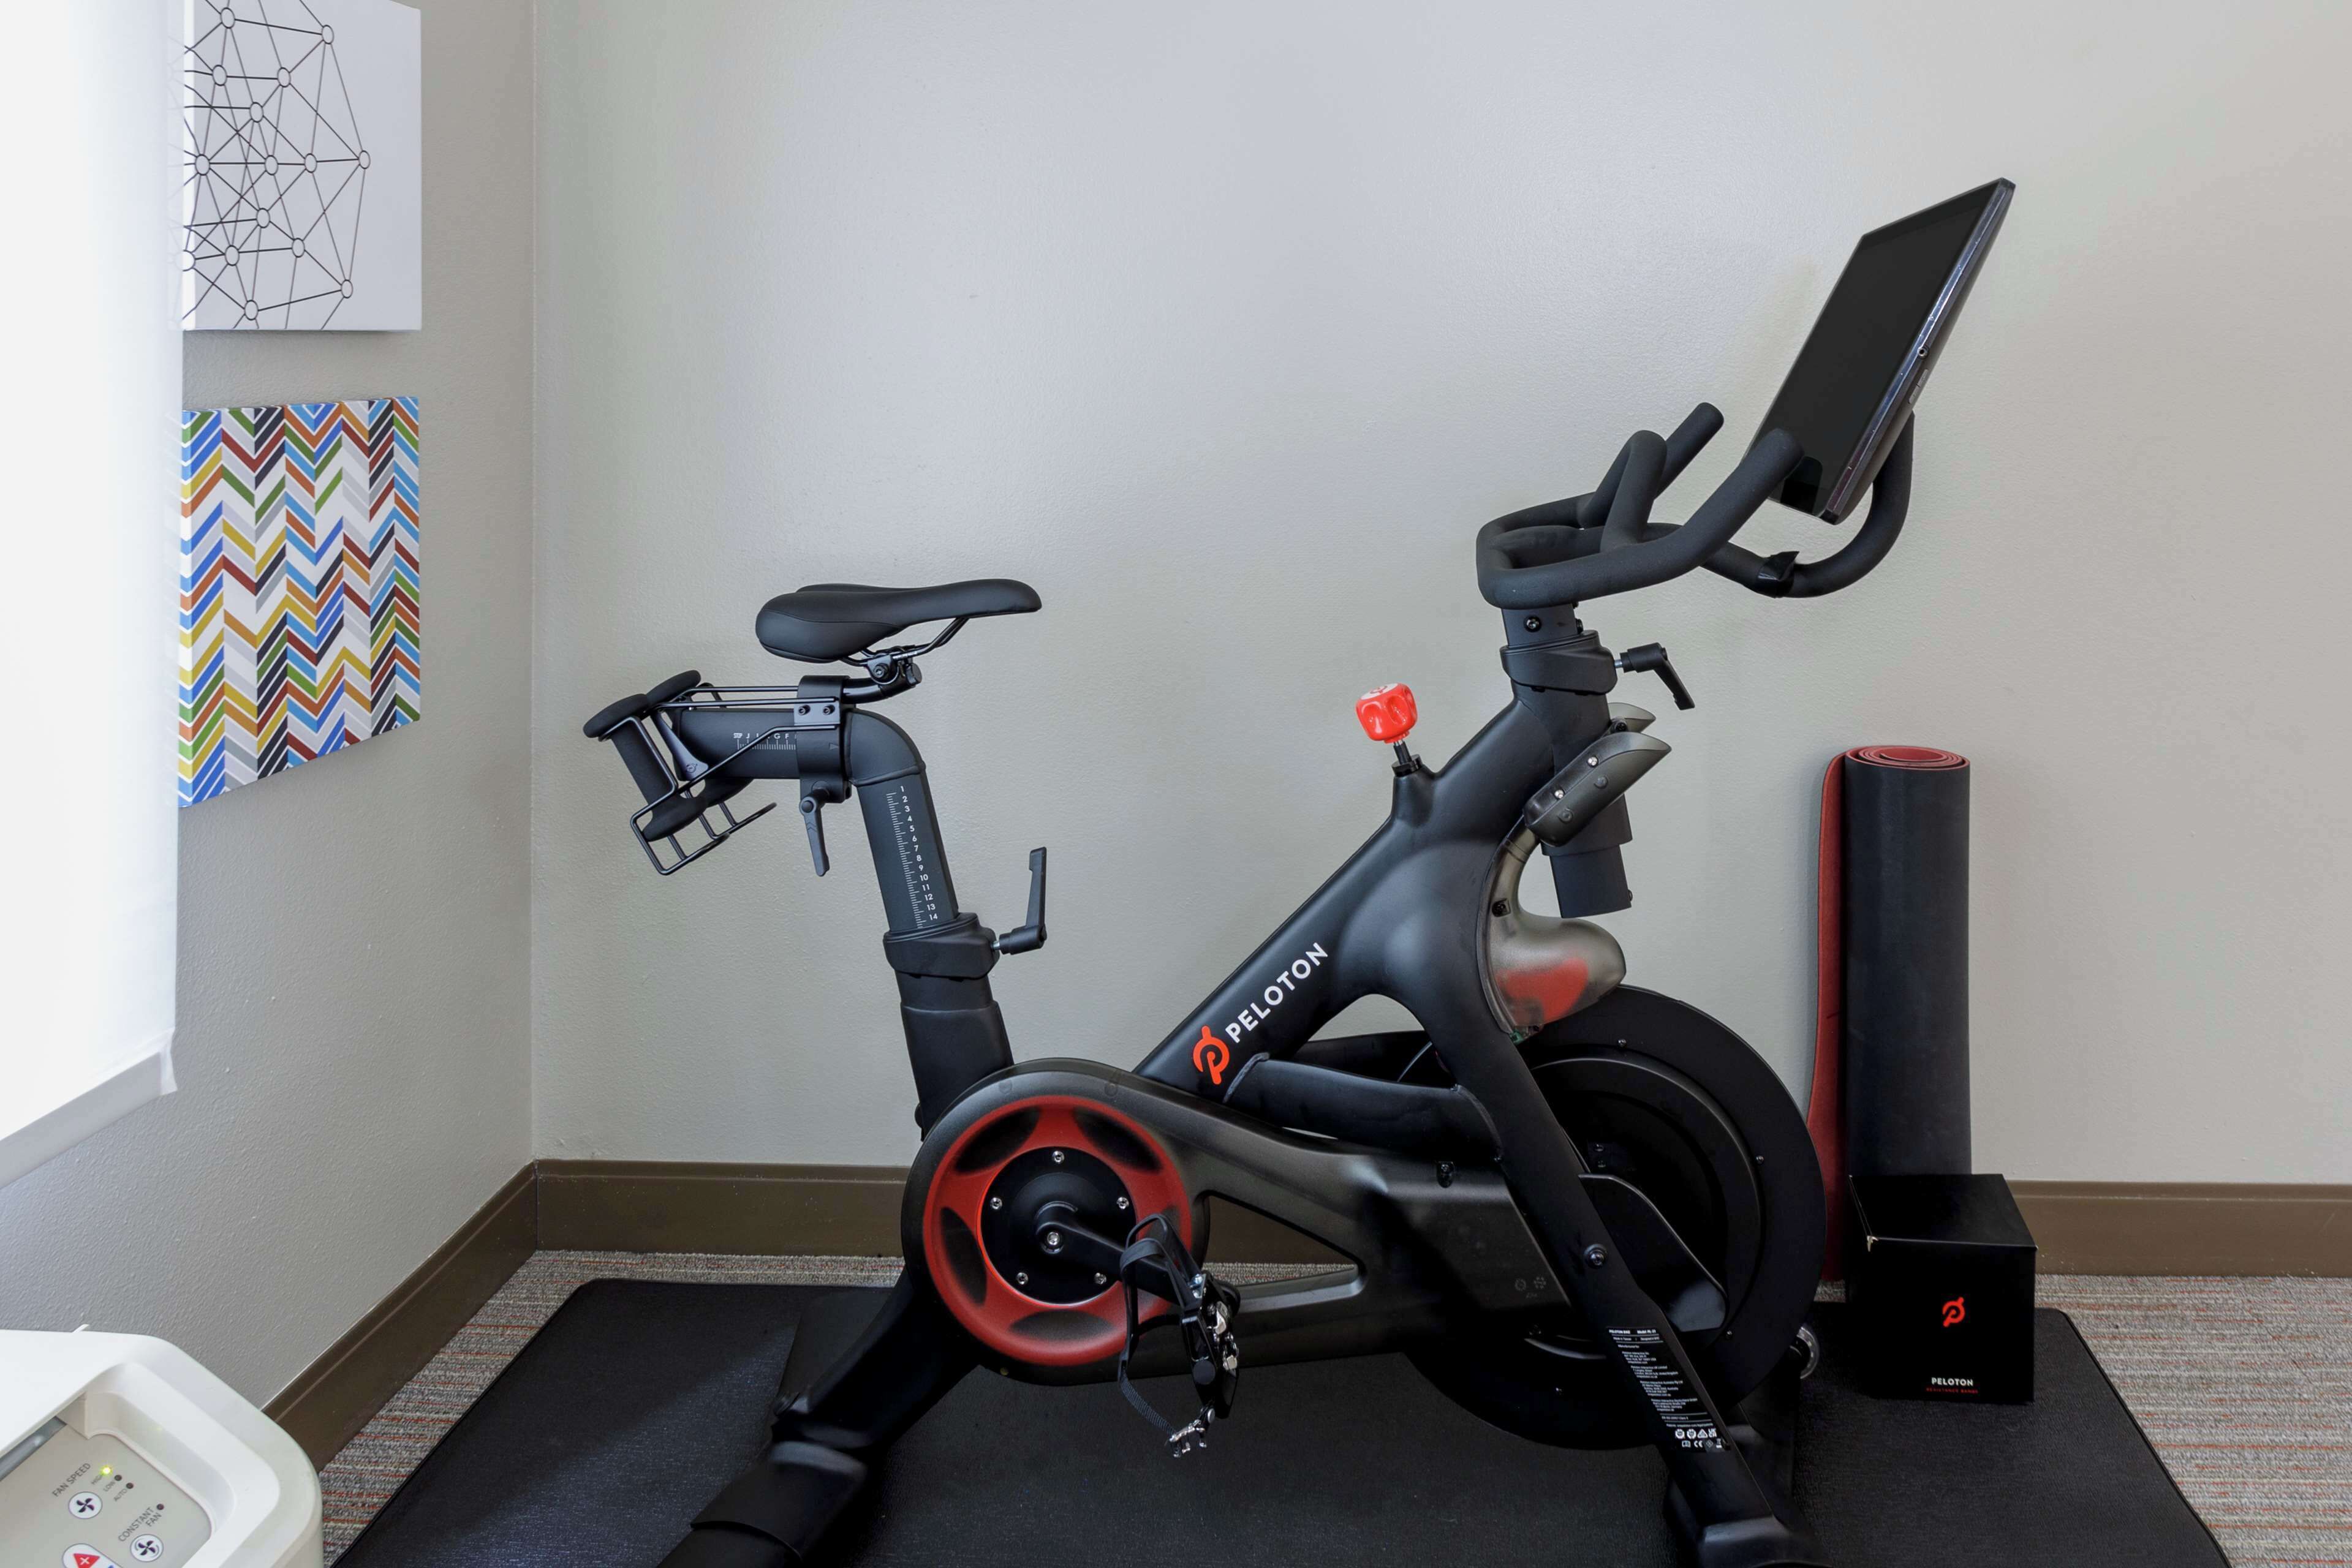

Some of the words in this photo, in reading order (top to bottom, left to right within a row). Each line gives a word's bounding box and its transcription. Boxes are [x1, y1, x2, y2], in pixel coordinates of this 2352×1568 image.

[1225, 942, 1328, 1043] PELOTON
[1931, 1377, 1973, 1387] PELOTON
[52, 1482, 69, 1497] FAN
[66, 1463, 91, 1484] SPEED
[103, 1481, 116, 1492] LOW
[113, 1488, 127, 1502] AUTO
[118, 1507, 154, 1541] CONSTANT
[145, 1512, 162, 1527] FAN
